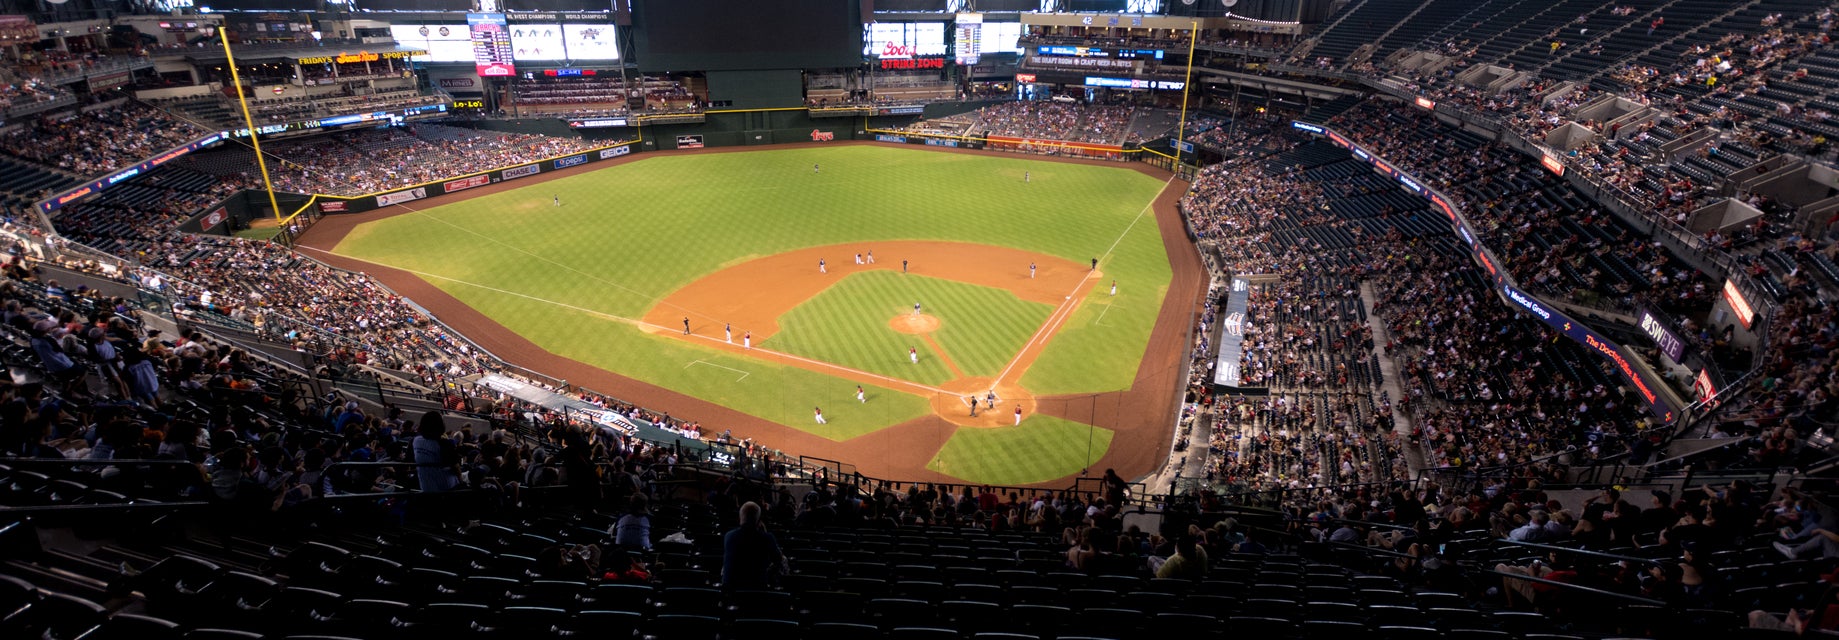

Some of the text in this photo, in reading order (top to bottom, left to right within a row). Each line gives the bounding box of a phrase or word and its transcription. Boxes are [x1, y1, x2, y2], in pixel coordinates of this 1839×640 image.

[1082, 16, 1093, 25] 42
[882, 41, 917, 56] Coors
[298, 56, 333, 65] FRIDAYS
[382, 51, 410, 60] SPORTS
[881, 59, 916, 69] STRIKE
[917, 58, 945, 68] ZONE
[505, 167, 530, 178] CHASE
[1510, 290, 1533, 309] Medical
[1532, 303, 1551, 320] Group
[1586, 334, 1599, 349] The
